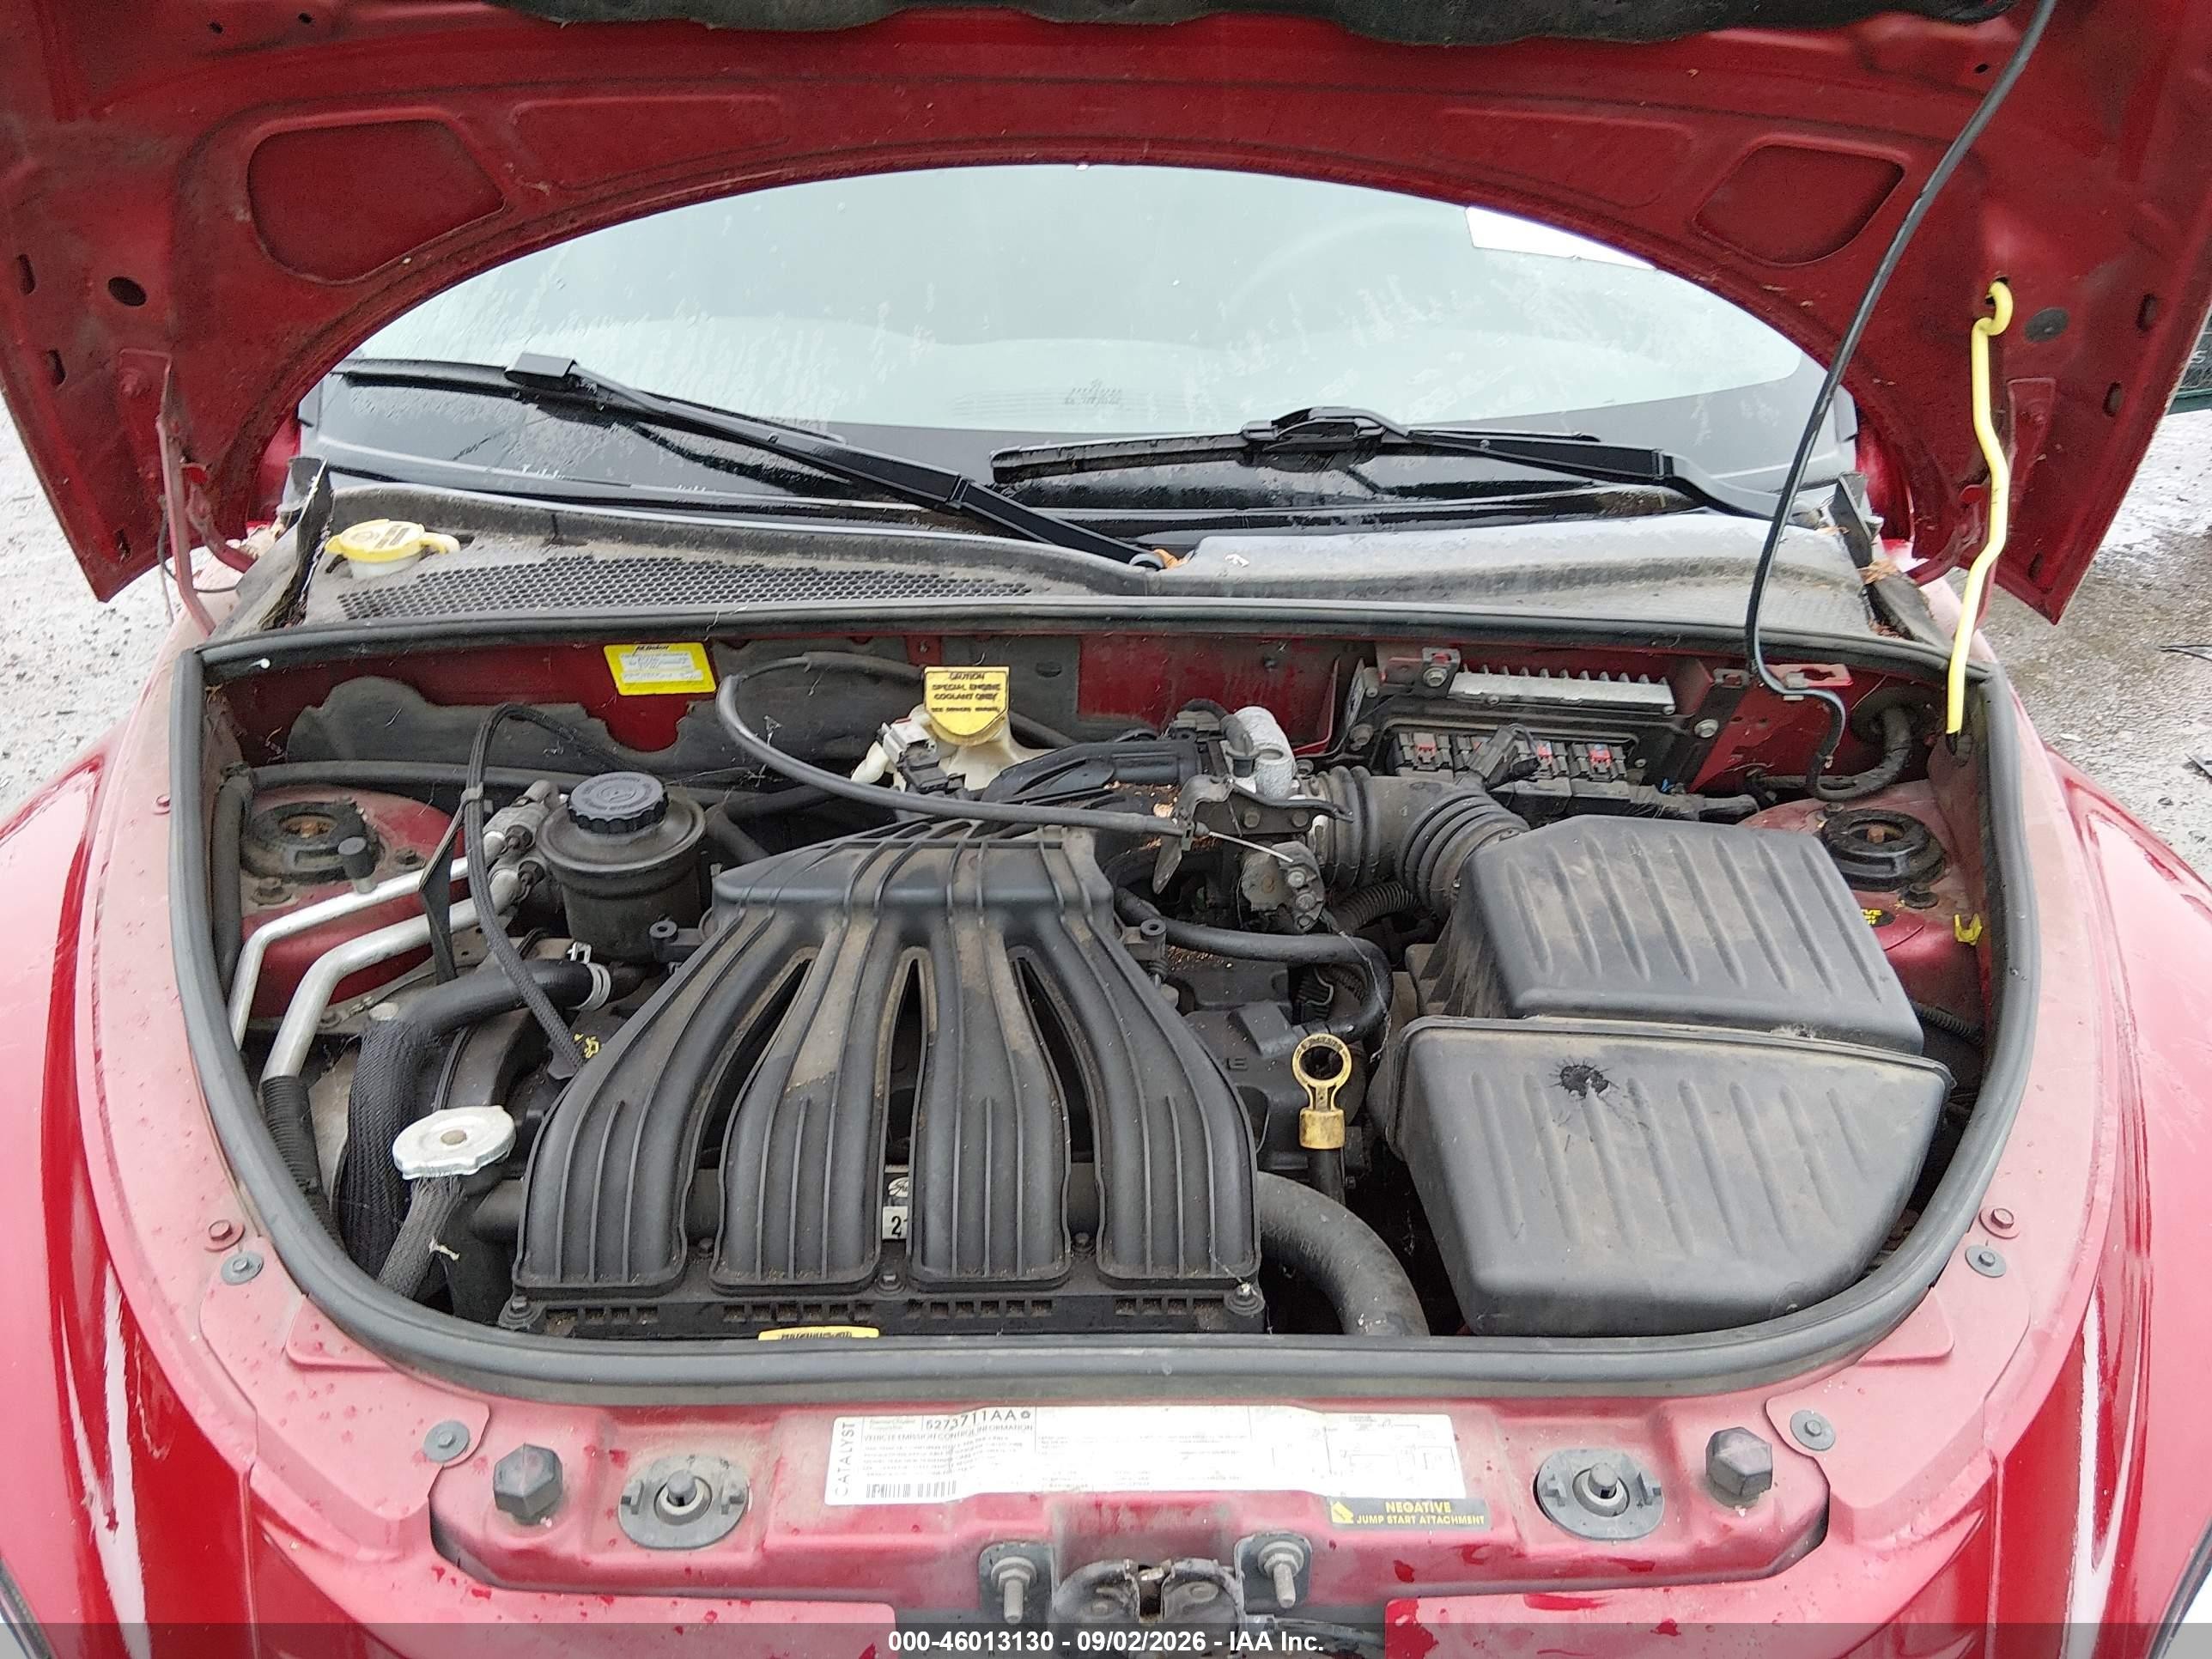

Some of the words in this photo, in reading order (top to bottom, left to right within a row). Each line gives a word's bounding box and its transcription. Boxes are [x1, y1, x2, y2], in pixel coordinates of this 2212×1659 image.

[864, 1434, 896, 1443] VEHICLE
[897, 1433, 936, 1442] EMISSION
[938, 1429, 975, 1441] CONTROL
[976, 1424, 1033, 1434] INFORMATION
[835, 1422, 855, 1497] CATALYST
[1385, 1501, 1451, 1513] NEGATIVE
[1357, 1515, 1384, 1524] JUMP
[1387, 1515, 1416, 1524] START
[1419, 1515, 1485, 1525] ATTACHMENT
